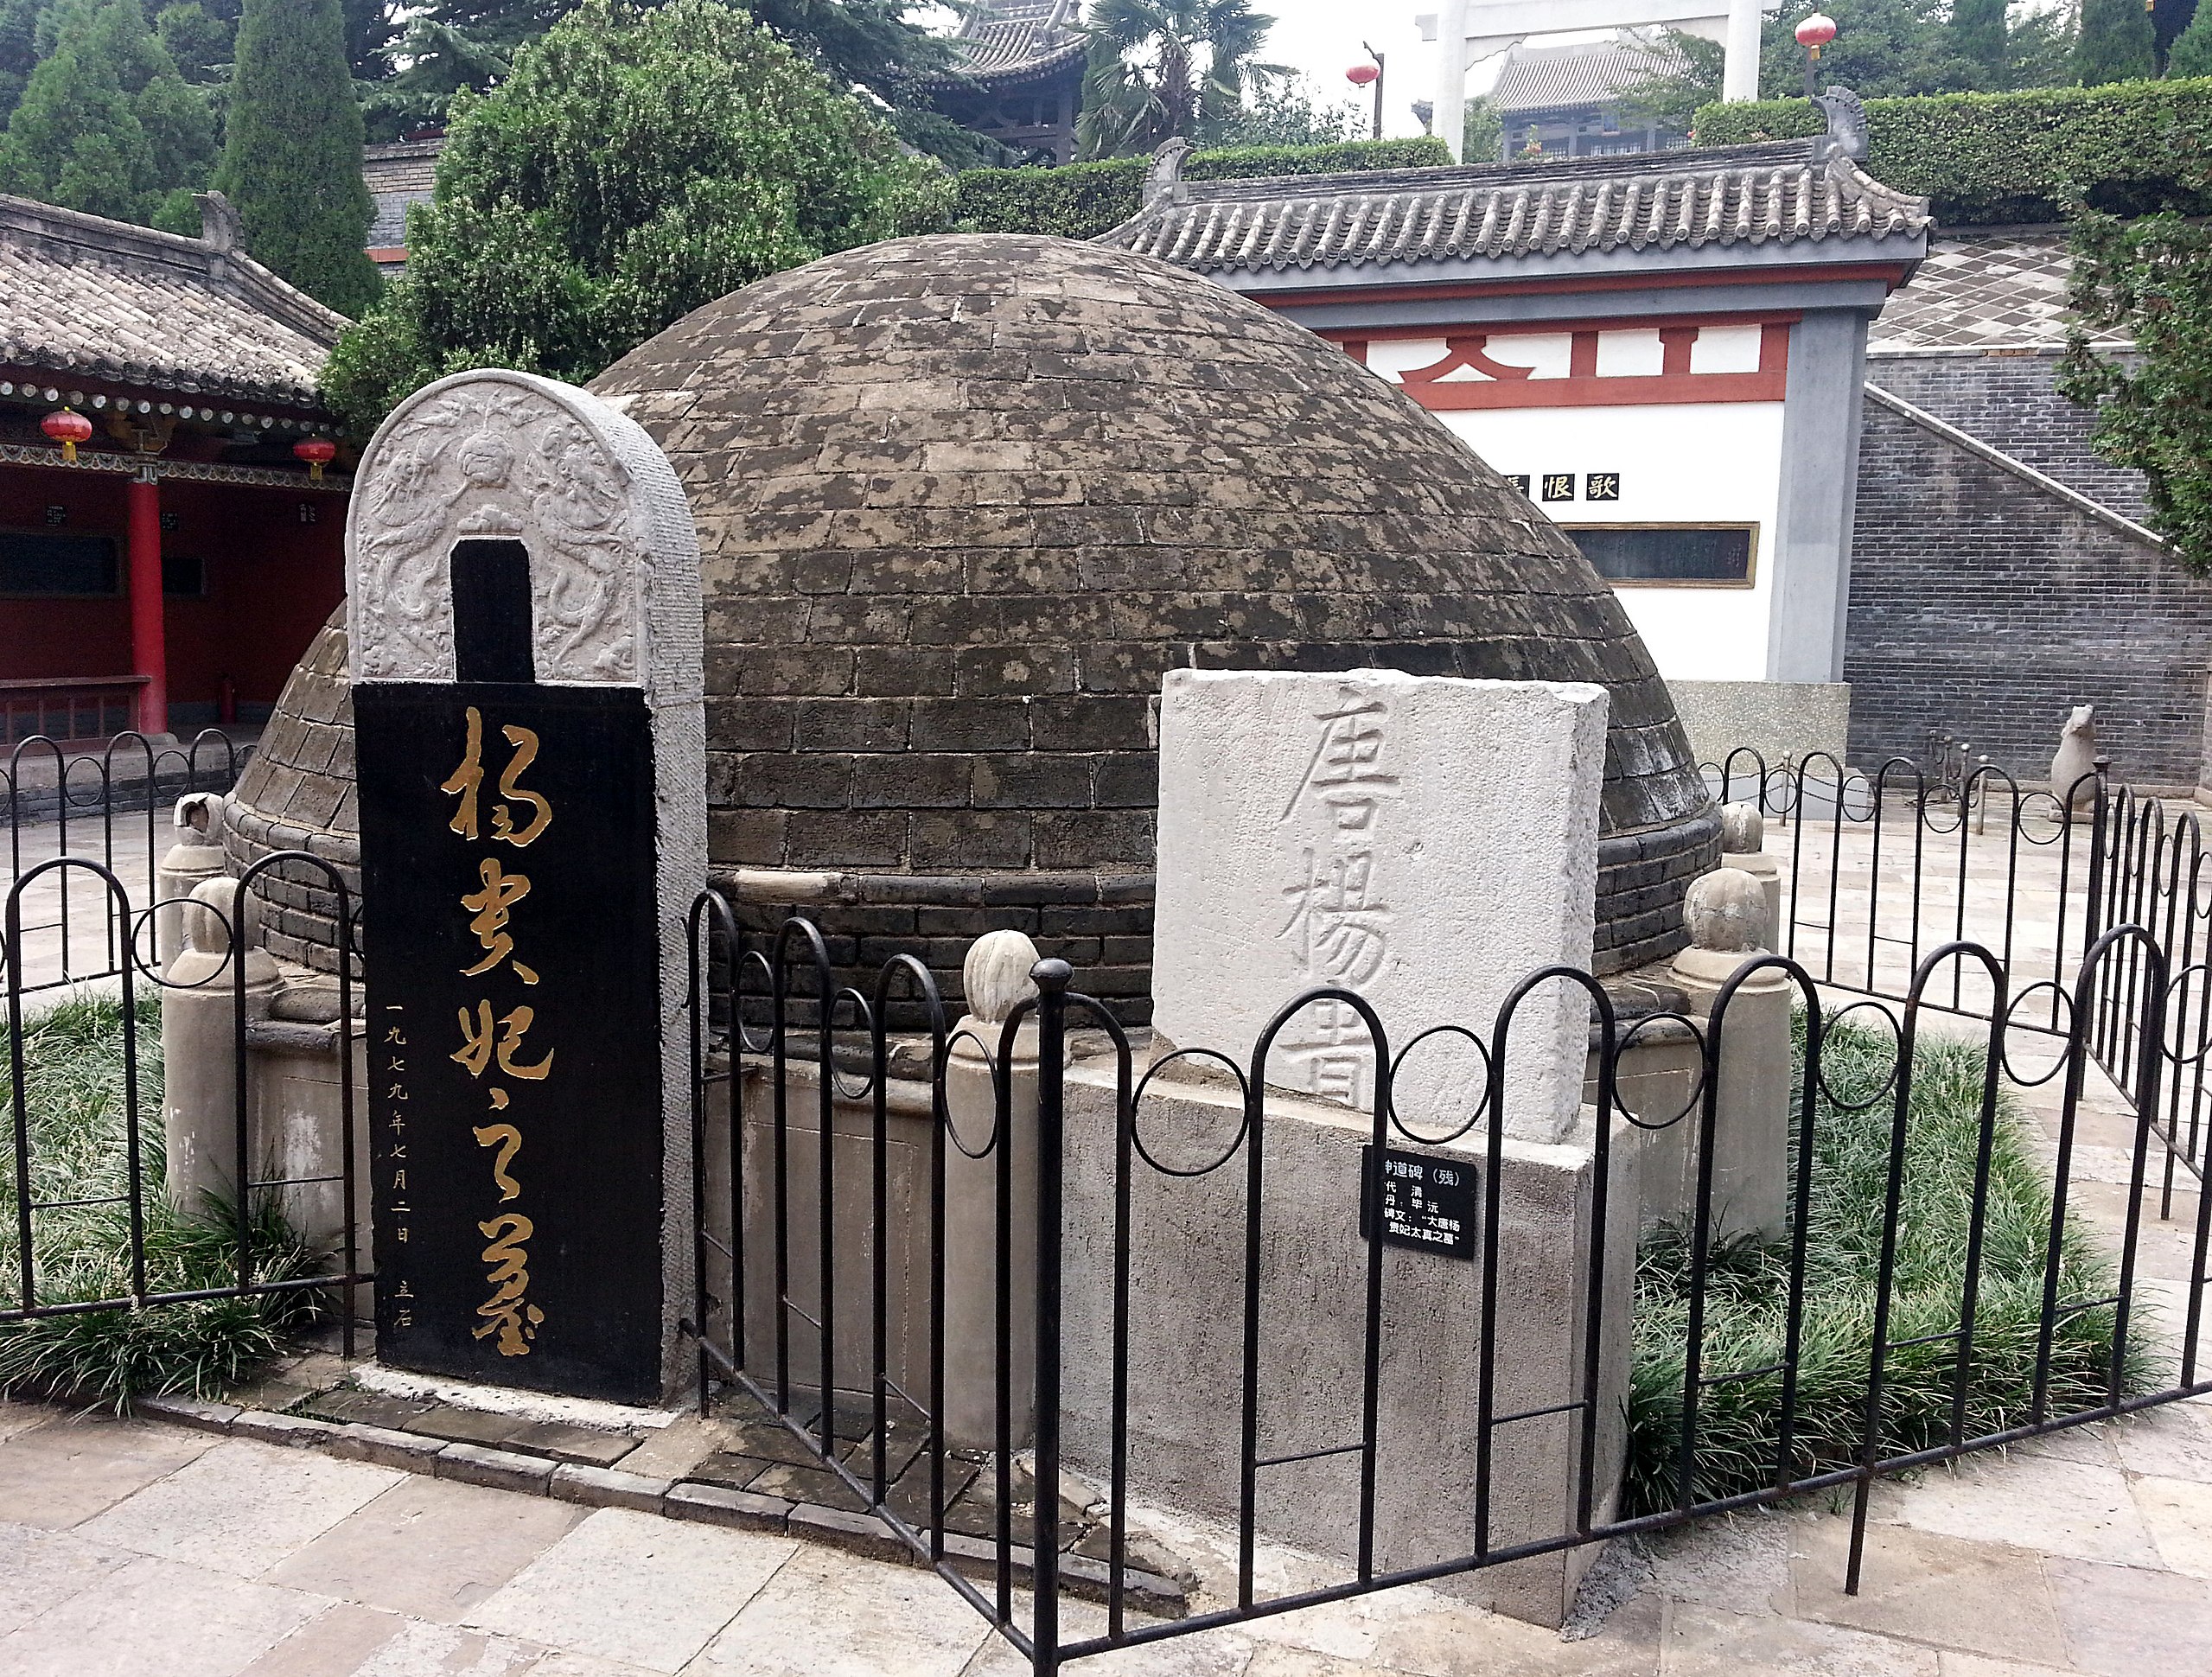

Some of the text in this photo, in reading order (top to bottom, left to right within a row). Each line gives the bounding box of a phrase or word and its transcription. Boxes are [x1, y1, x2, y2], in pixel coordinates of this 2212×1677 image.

[384, 1004, 411, 1244] 一九七九年七月二日
